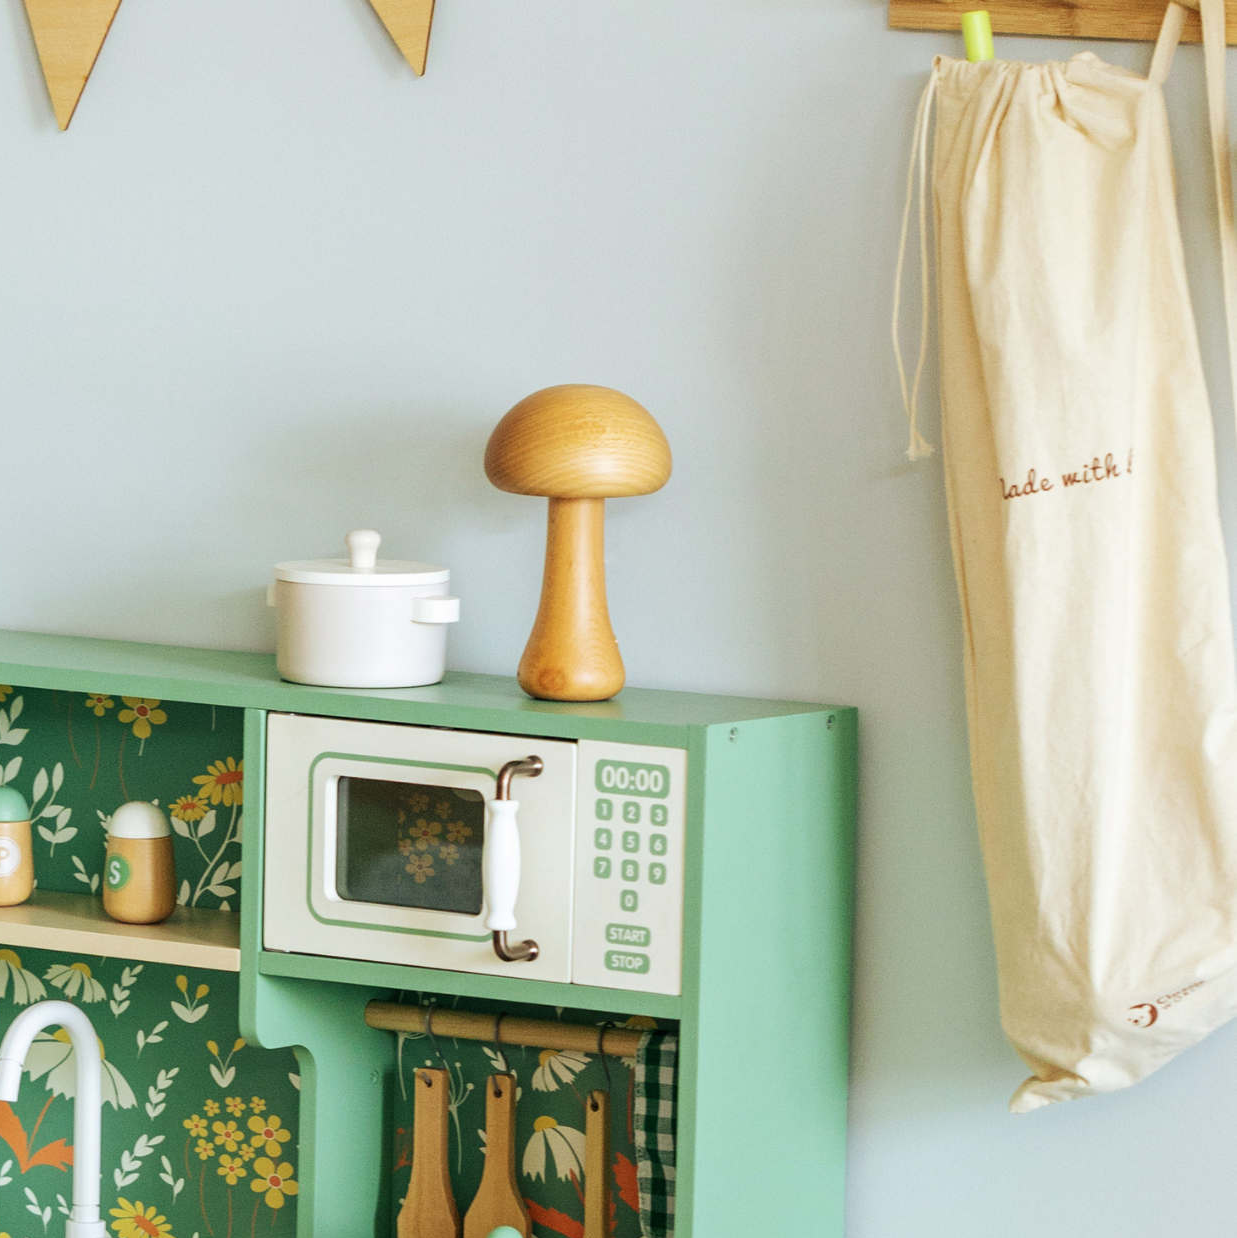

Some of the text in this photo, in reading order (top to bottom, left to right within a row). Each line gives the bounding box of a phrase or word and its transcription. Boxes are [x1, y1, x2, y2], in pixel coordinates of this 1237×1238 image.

[1000, 468, 1054, 500] ade
[1062, 453, 1120, 487] with
[601, 765, 663, 792] 00:00
[601, 804, 663, 822] 1 2 3
[599, 833, 662, 851] 4 5 6
[109, 861, 121, 885] S
[599, 862, 661, 880] 7 8 9
[625, 895, 633, 907] 0
[610, 927, 647, 943] START
[612, 955, 643, 969] STOP
